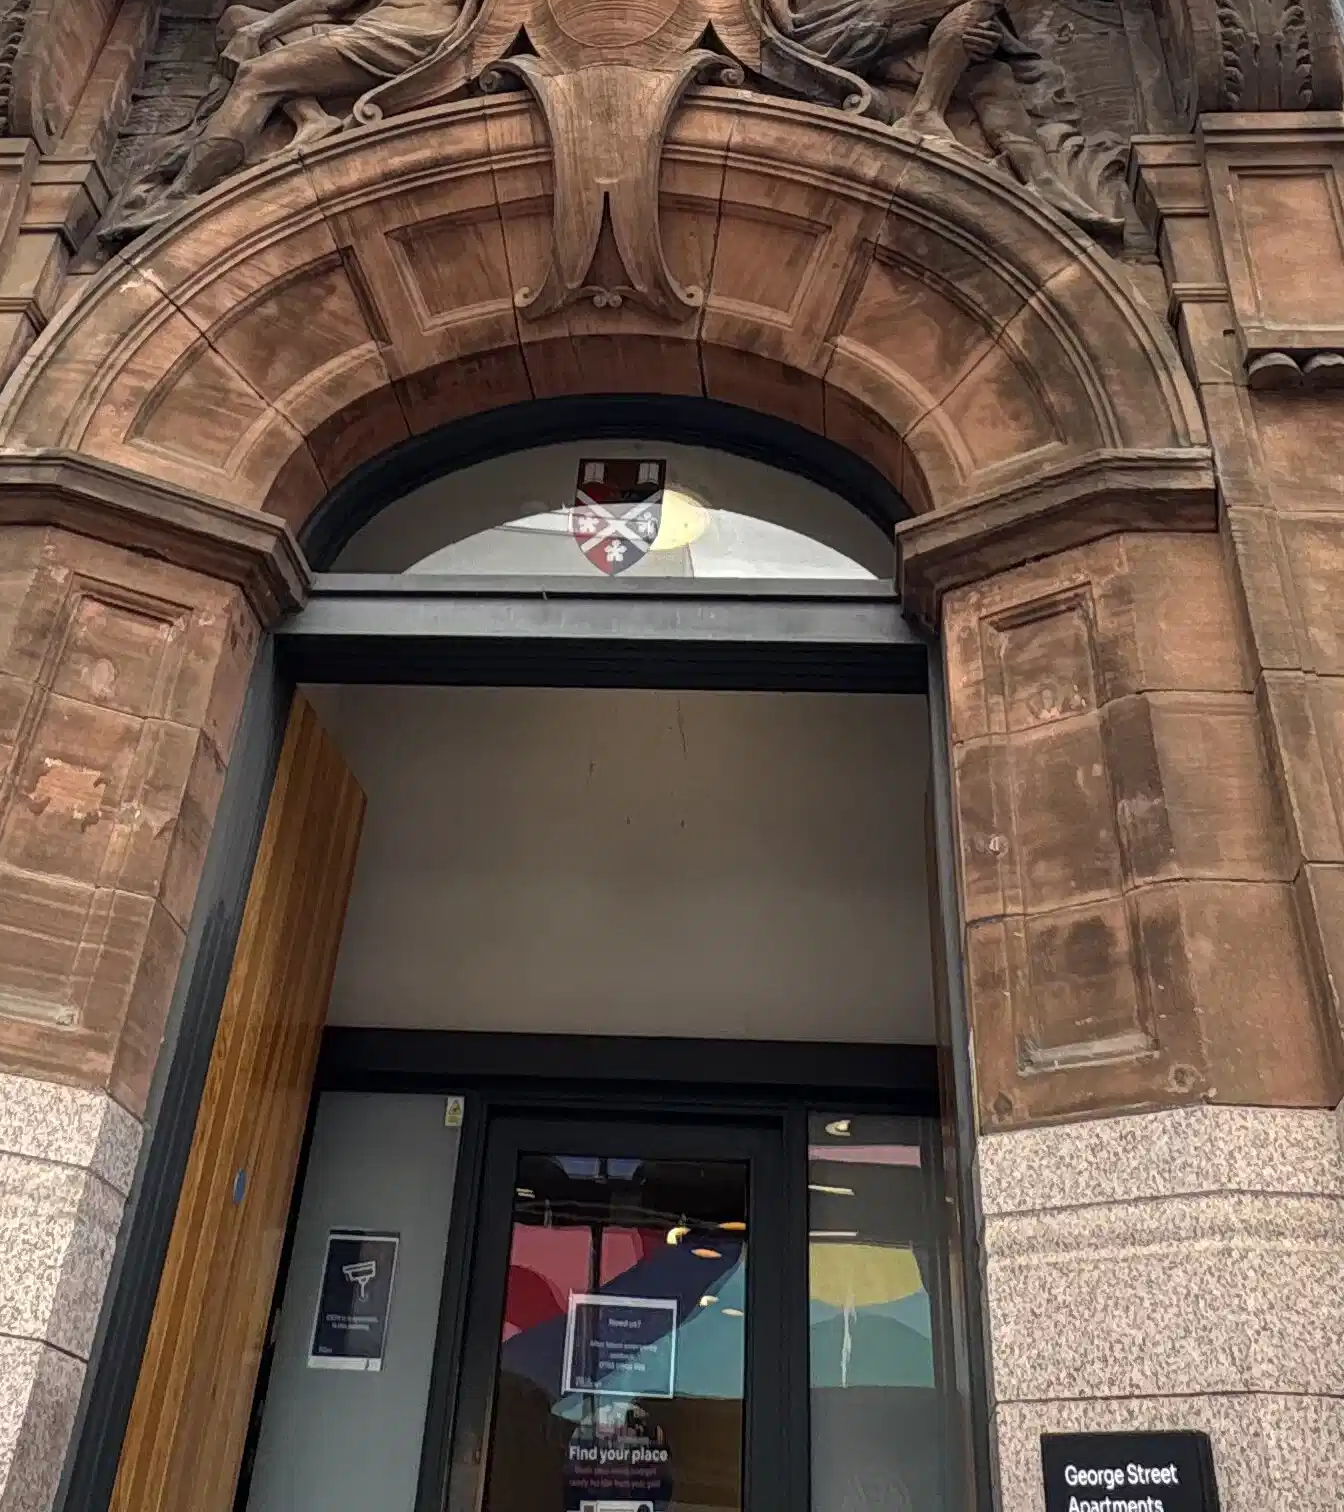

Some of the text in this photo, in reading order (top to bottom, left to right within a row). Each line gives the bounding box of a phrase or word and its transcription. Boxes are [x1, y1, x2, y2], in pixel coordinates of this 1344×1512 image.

[569, 1445, 668, 1465] Find your place
[1064, 1462, 1178, 1489] George Street
[1068, 1495, 1165, 1512] Apartments
